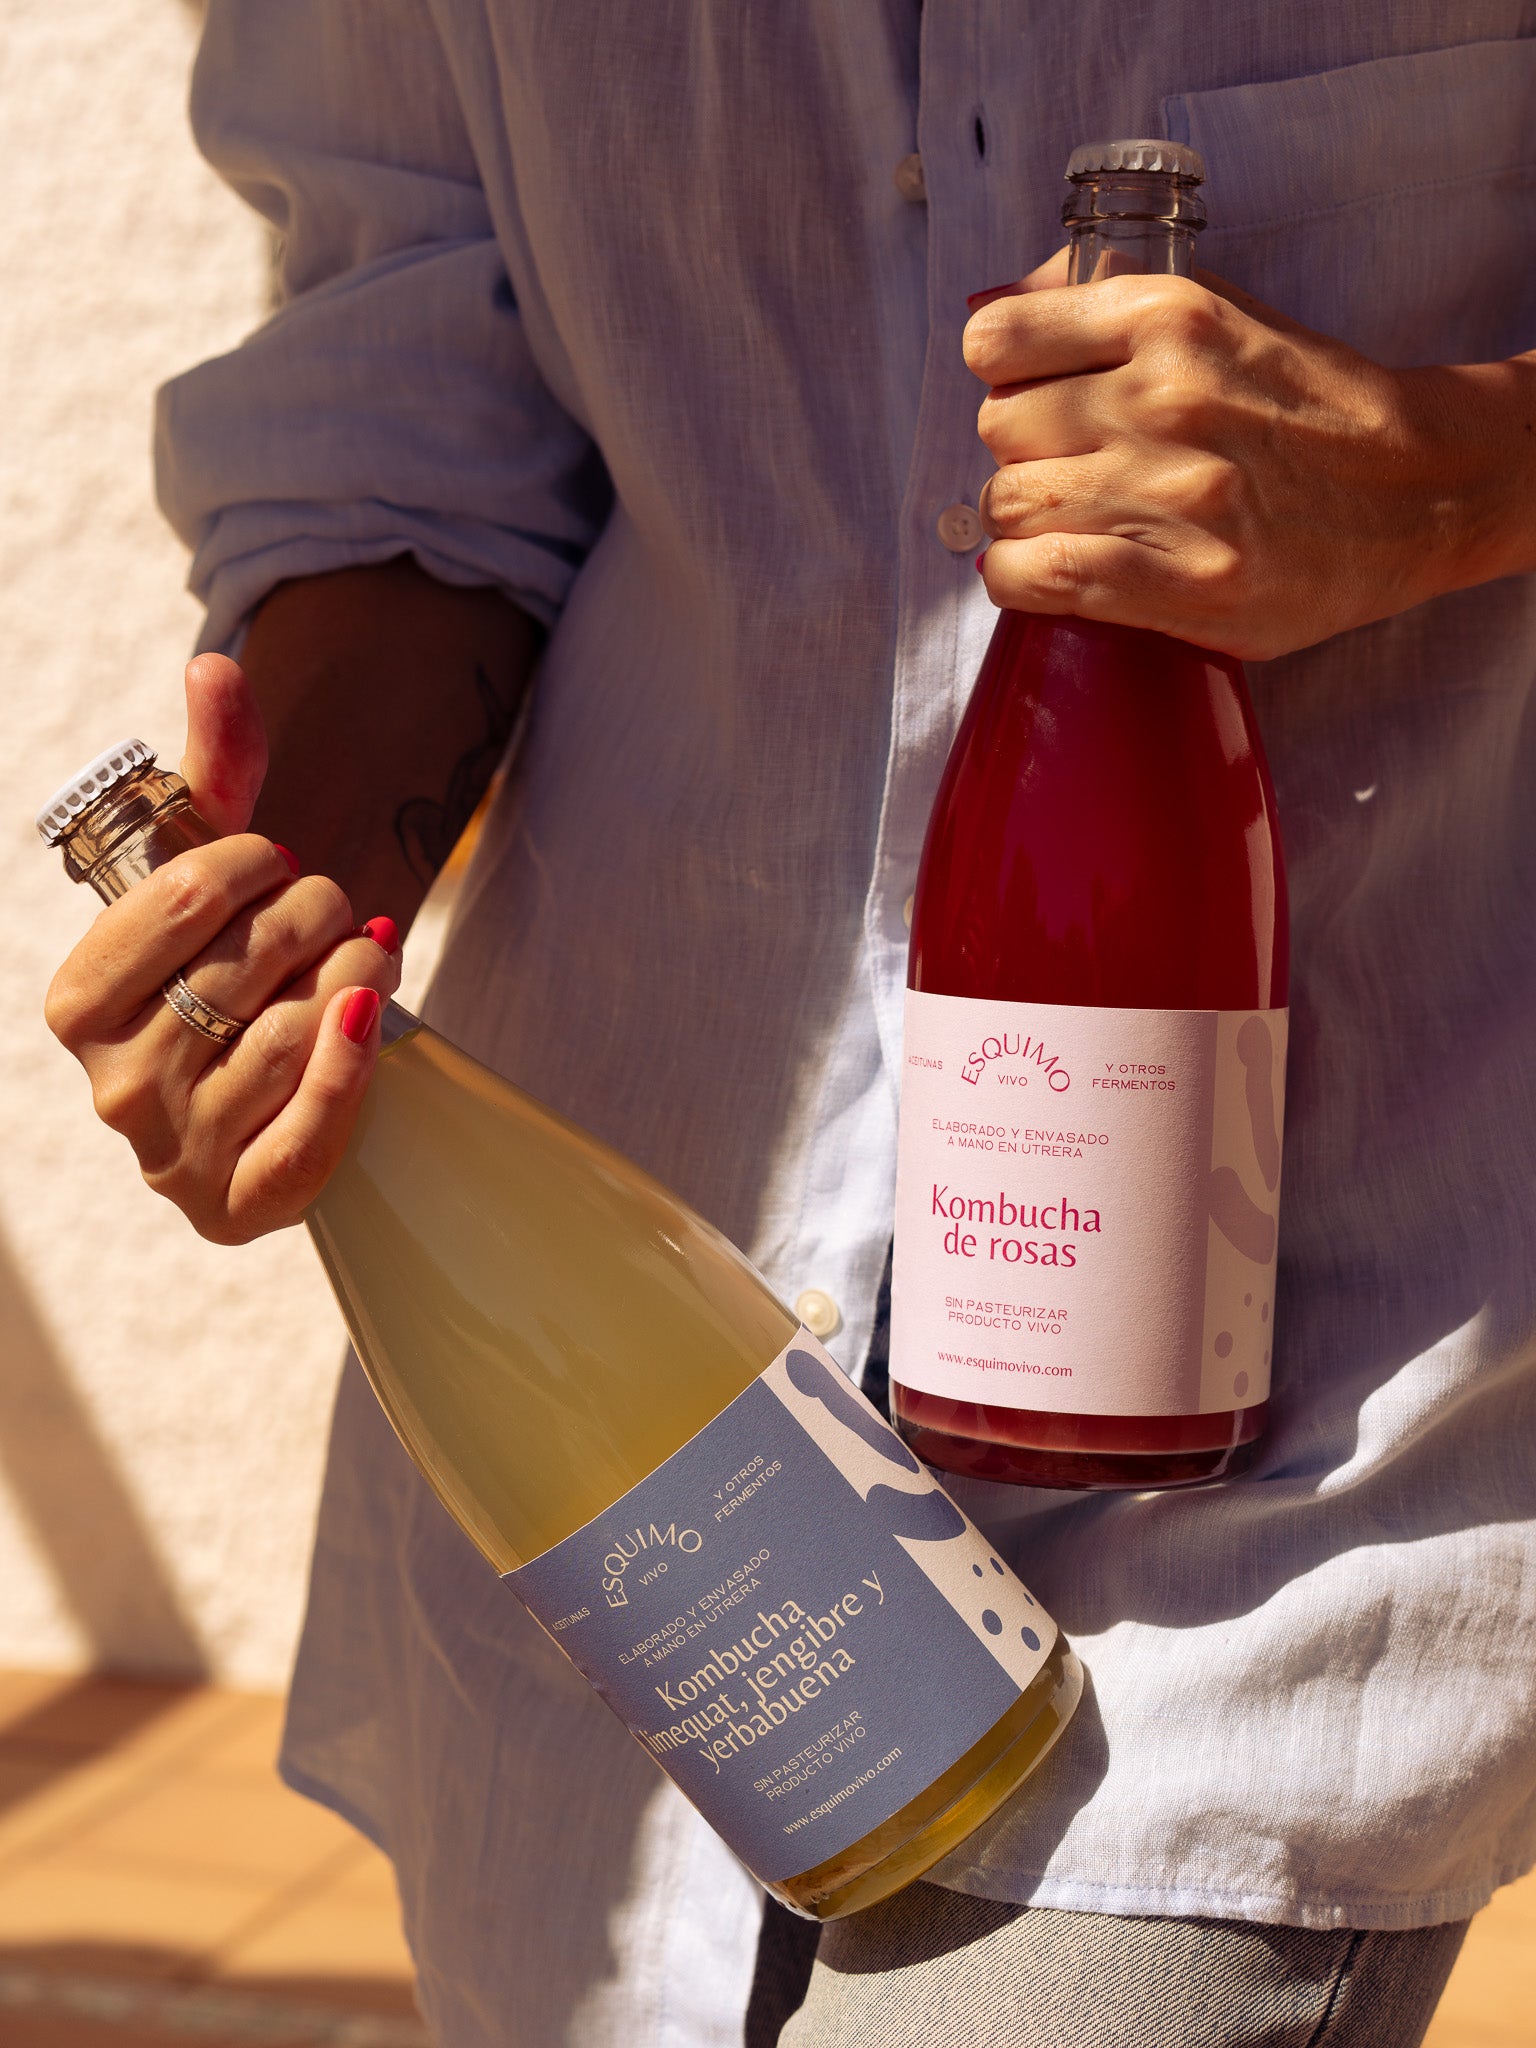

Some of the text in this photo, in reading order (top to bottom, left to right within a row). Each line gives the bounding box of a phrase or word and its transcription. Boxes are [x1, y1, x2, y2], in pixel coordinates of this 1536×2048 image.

[961, 1033, 1070, 1092] ESQUIMO
[997, 1074, 1028, 1086] VIVO
[1092, 1078, 1176, 1091] FERMENTOS
[1105, 1063, 1166, 1075] Y OTROS
[932, 1118, 1109, 1146] ELABORADO Y ENVASADO
[947, 1136, 1083, 1159] A MANO EN UTRERA
[932, 1184, 1102, 1233] Kombucha
[944, 1223, 1077, 1268] de rosas
[945, 1296, 1068, 1321] SIN PASTEURIZAR
[948, 1311, 1061, 1335] PRODUCTO VIVO
[937, 1350, 1073, 1378] www.esquimovivo.com
[714, 1455, 764, 1500] Y OTROS
[714, 1460, 782, 1523] FERMENTOS
[602, 1523, 702, 1608] ESQUIMO
[638, 1562, 668, 1586] VIVO
[618, 1548, 770, 1665] ELABORADO Y ENVASADO
[644, 1578, 761, 1668] A MANO EN UTRERA
[639, 1570, 885, 1754] limequat, jengibre y
[654, 1600, 806, 1711] Kombucha
[699, 1648, 856, 1774] yerbabuena
[753, 1711, 862, 1792] SIN PASTEURIZAR
[766, 1726, 866, 1801] PRODUCTO VIVO
[783, 1748, 902, 1835] www.esquimovivo.com
